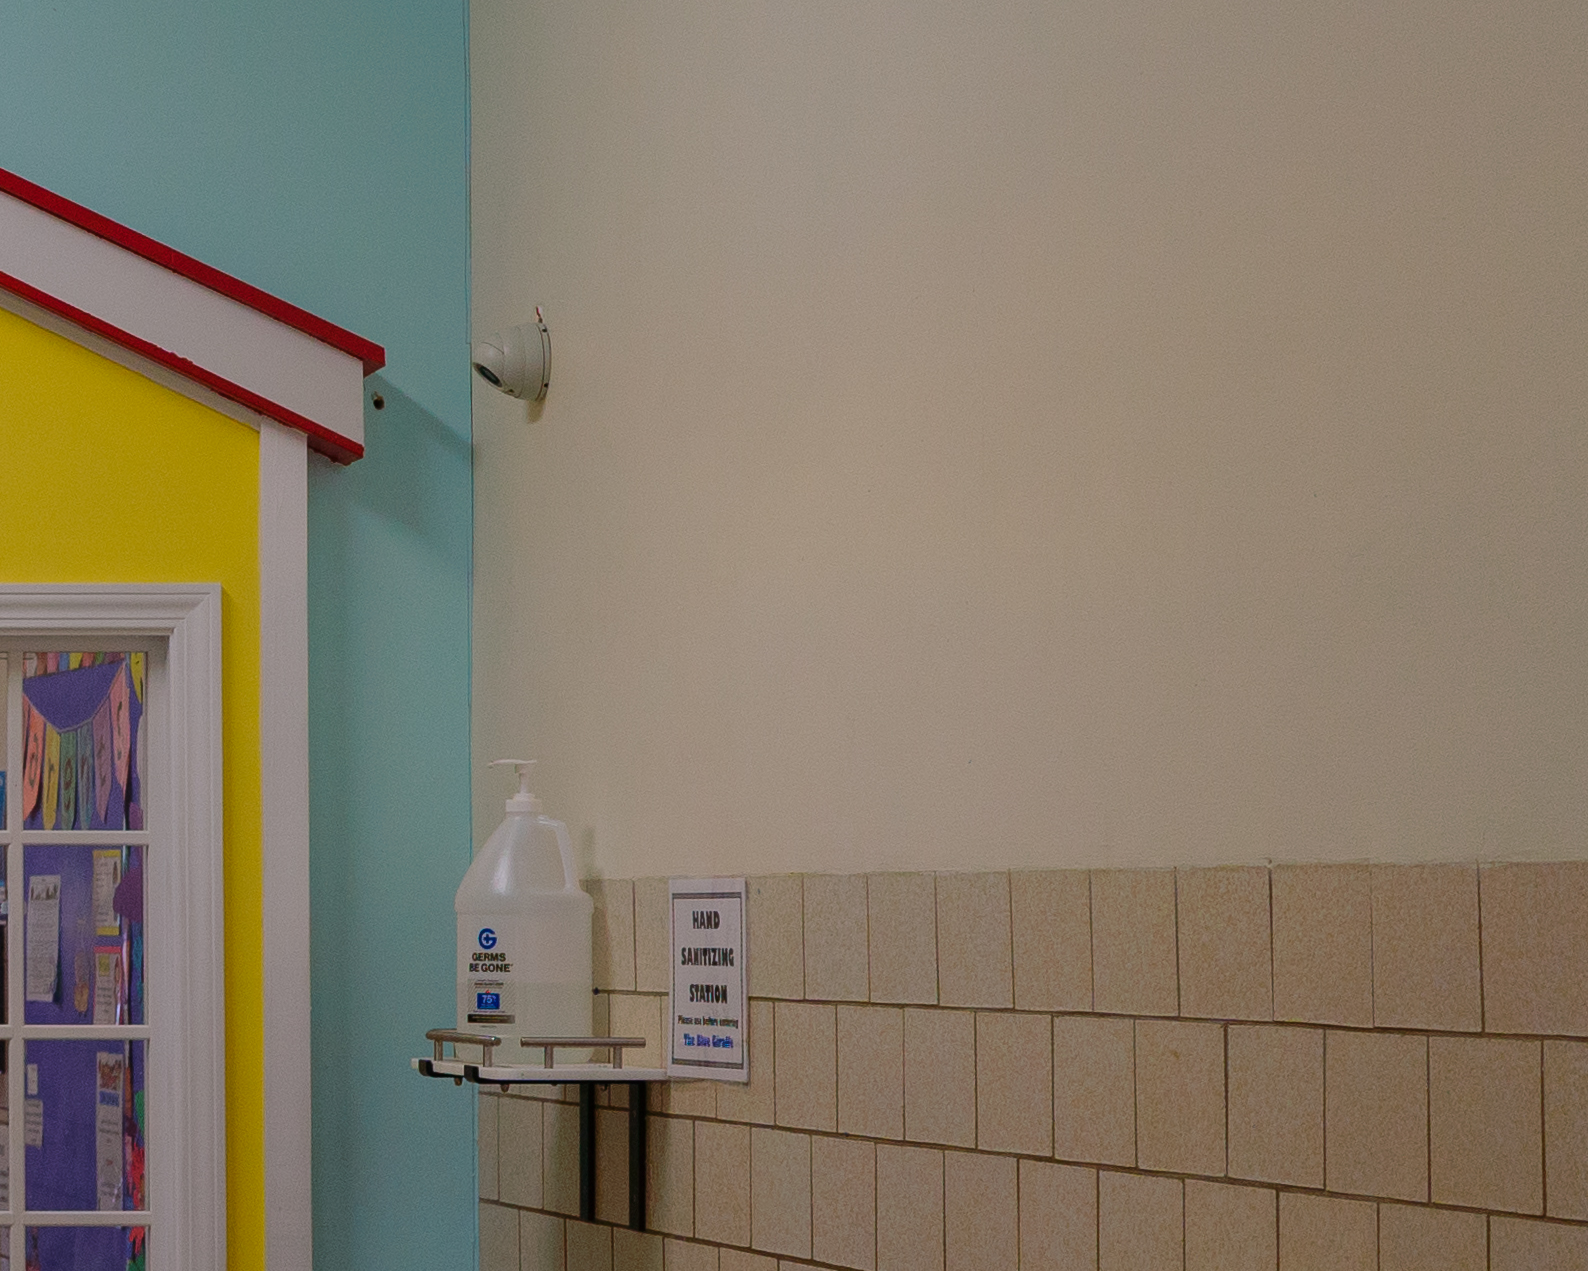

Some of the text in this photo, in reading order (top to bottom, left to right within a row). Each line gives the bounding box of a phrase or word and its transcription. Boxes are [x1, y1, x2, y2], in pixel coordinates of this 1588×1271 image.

[692, 910, 720, 929] HAND
[472, 952, 506, 962] GERMS
[681, 947, 734, 967] SANITIZING
[469, 963, 511, 973] BE GONE
[689, 984, 728, 1004] STATION
